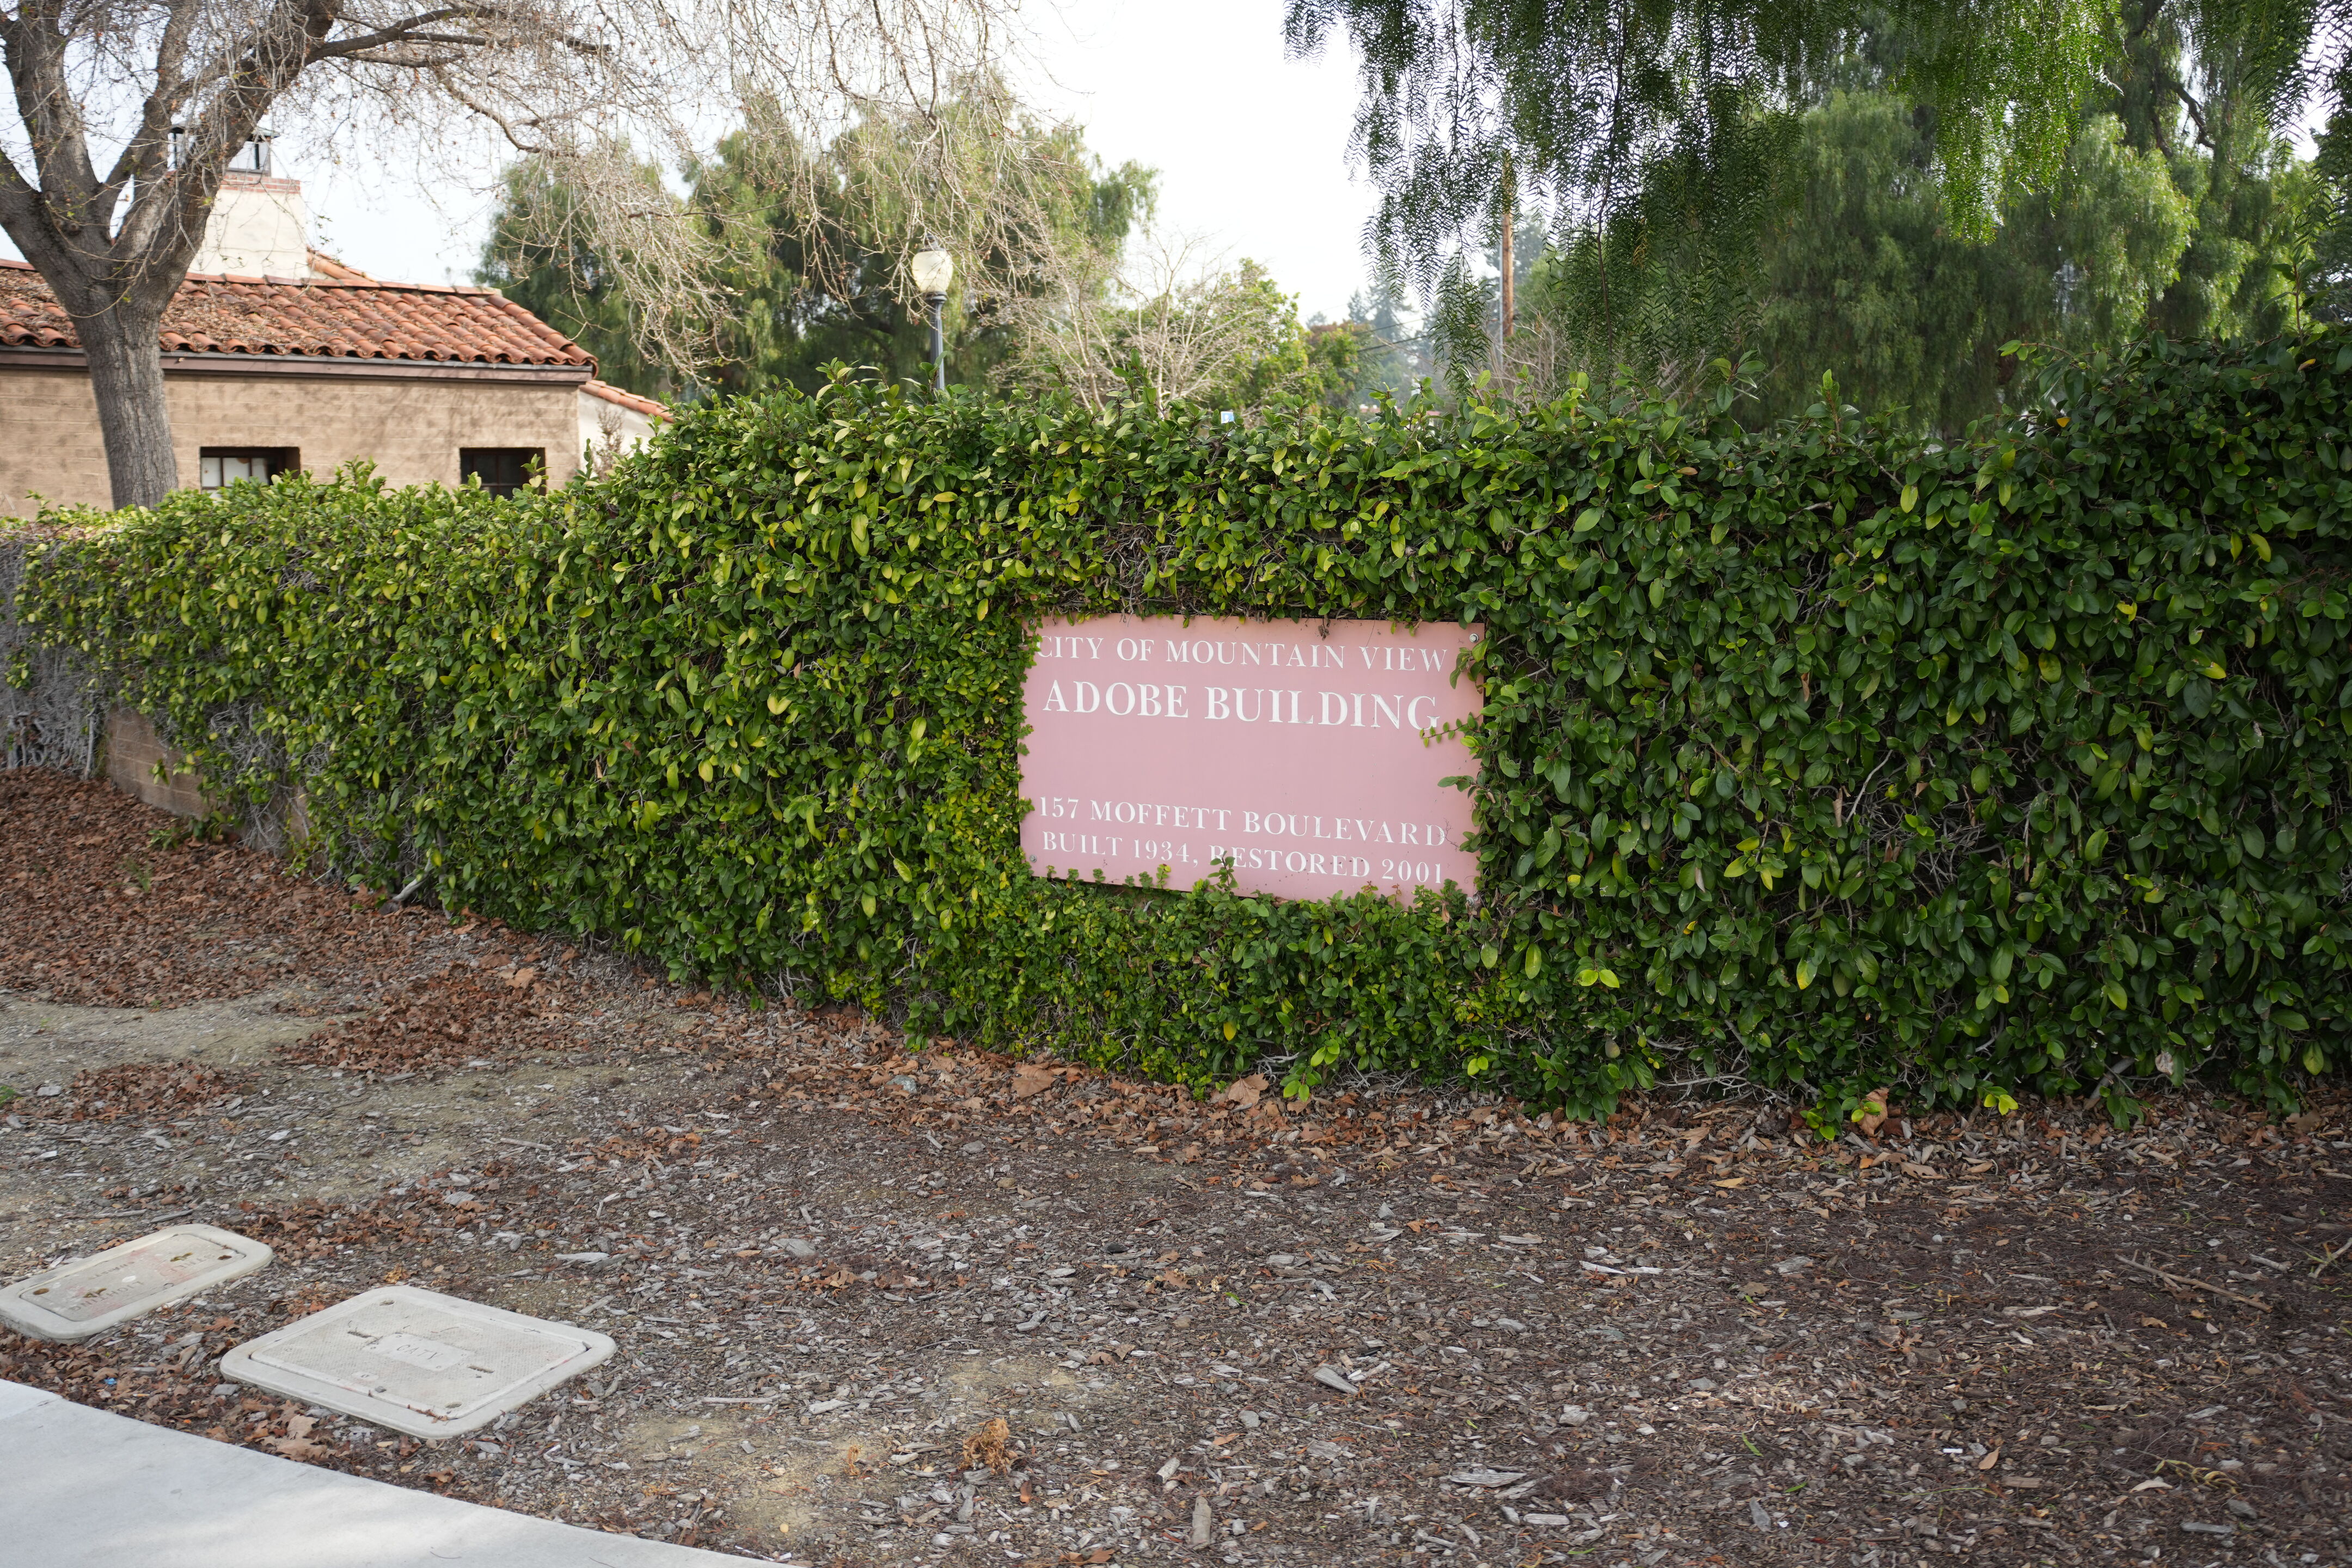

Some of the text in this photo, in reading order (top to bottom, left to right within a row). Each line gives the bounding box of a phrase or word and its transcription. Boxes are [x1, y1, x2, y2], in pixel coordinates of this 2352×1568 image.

[1036, 635, 1447, 672] CITY OF MOUNTAIN VIEW
[1043, 679, 1441, 731] ADOBE BUILDING
[1039, 796, 1446, 846] 157 MOFFETT BOULEVARD
[1042, 831, 1442, 884] BUILT 1934, RESTORED 2001
[69, 1281, 144, 1312] LIGHTING
[396, 1345, 443, 1359] CATV
